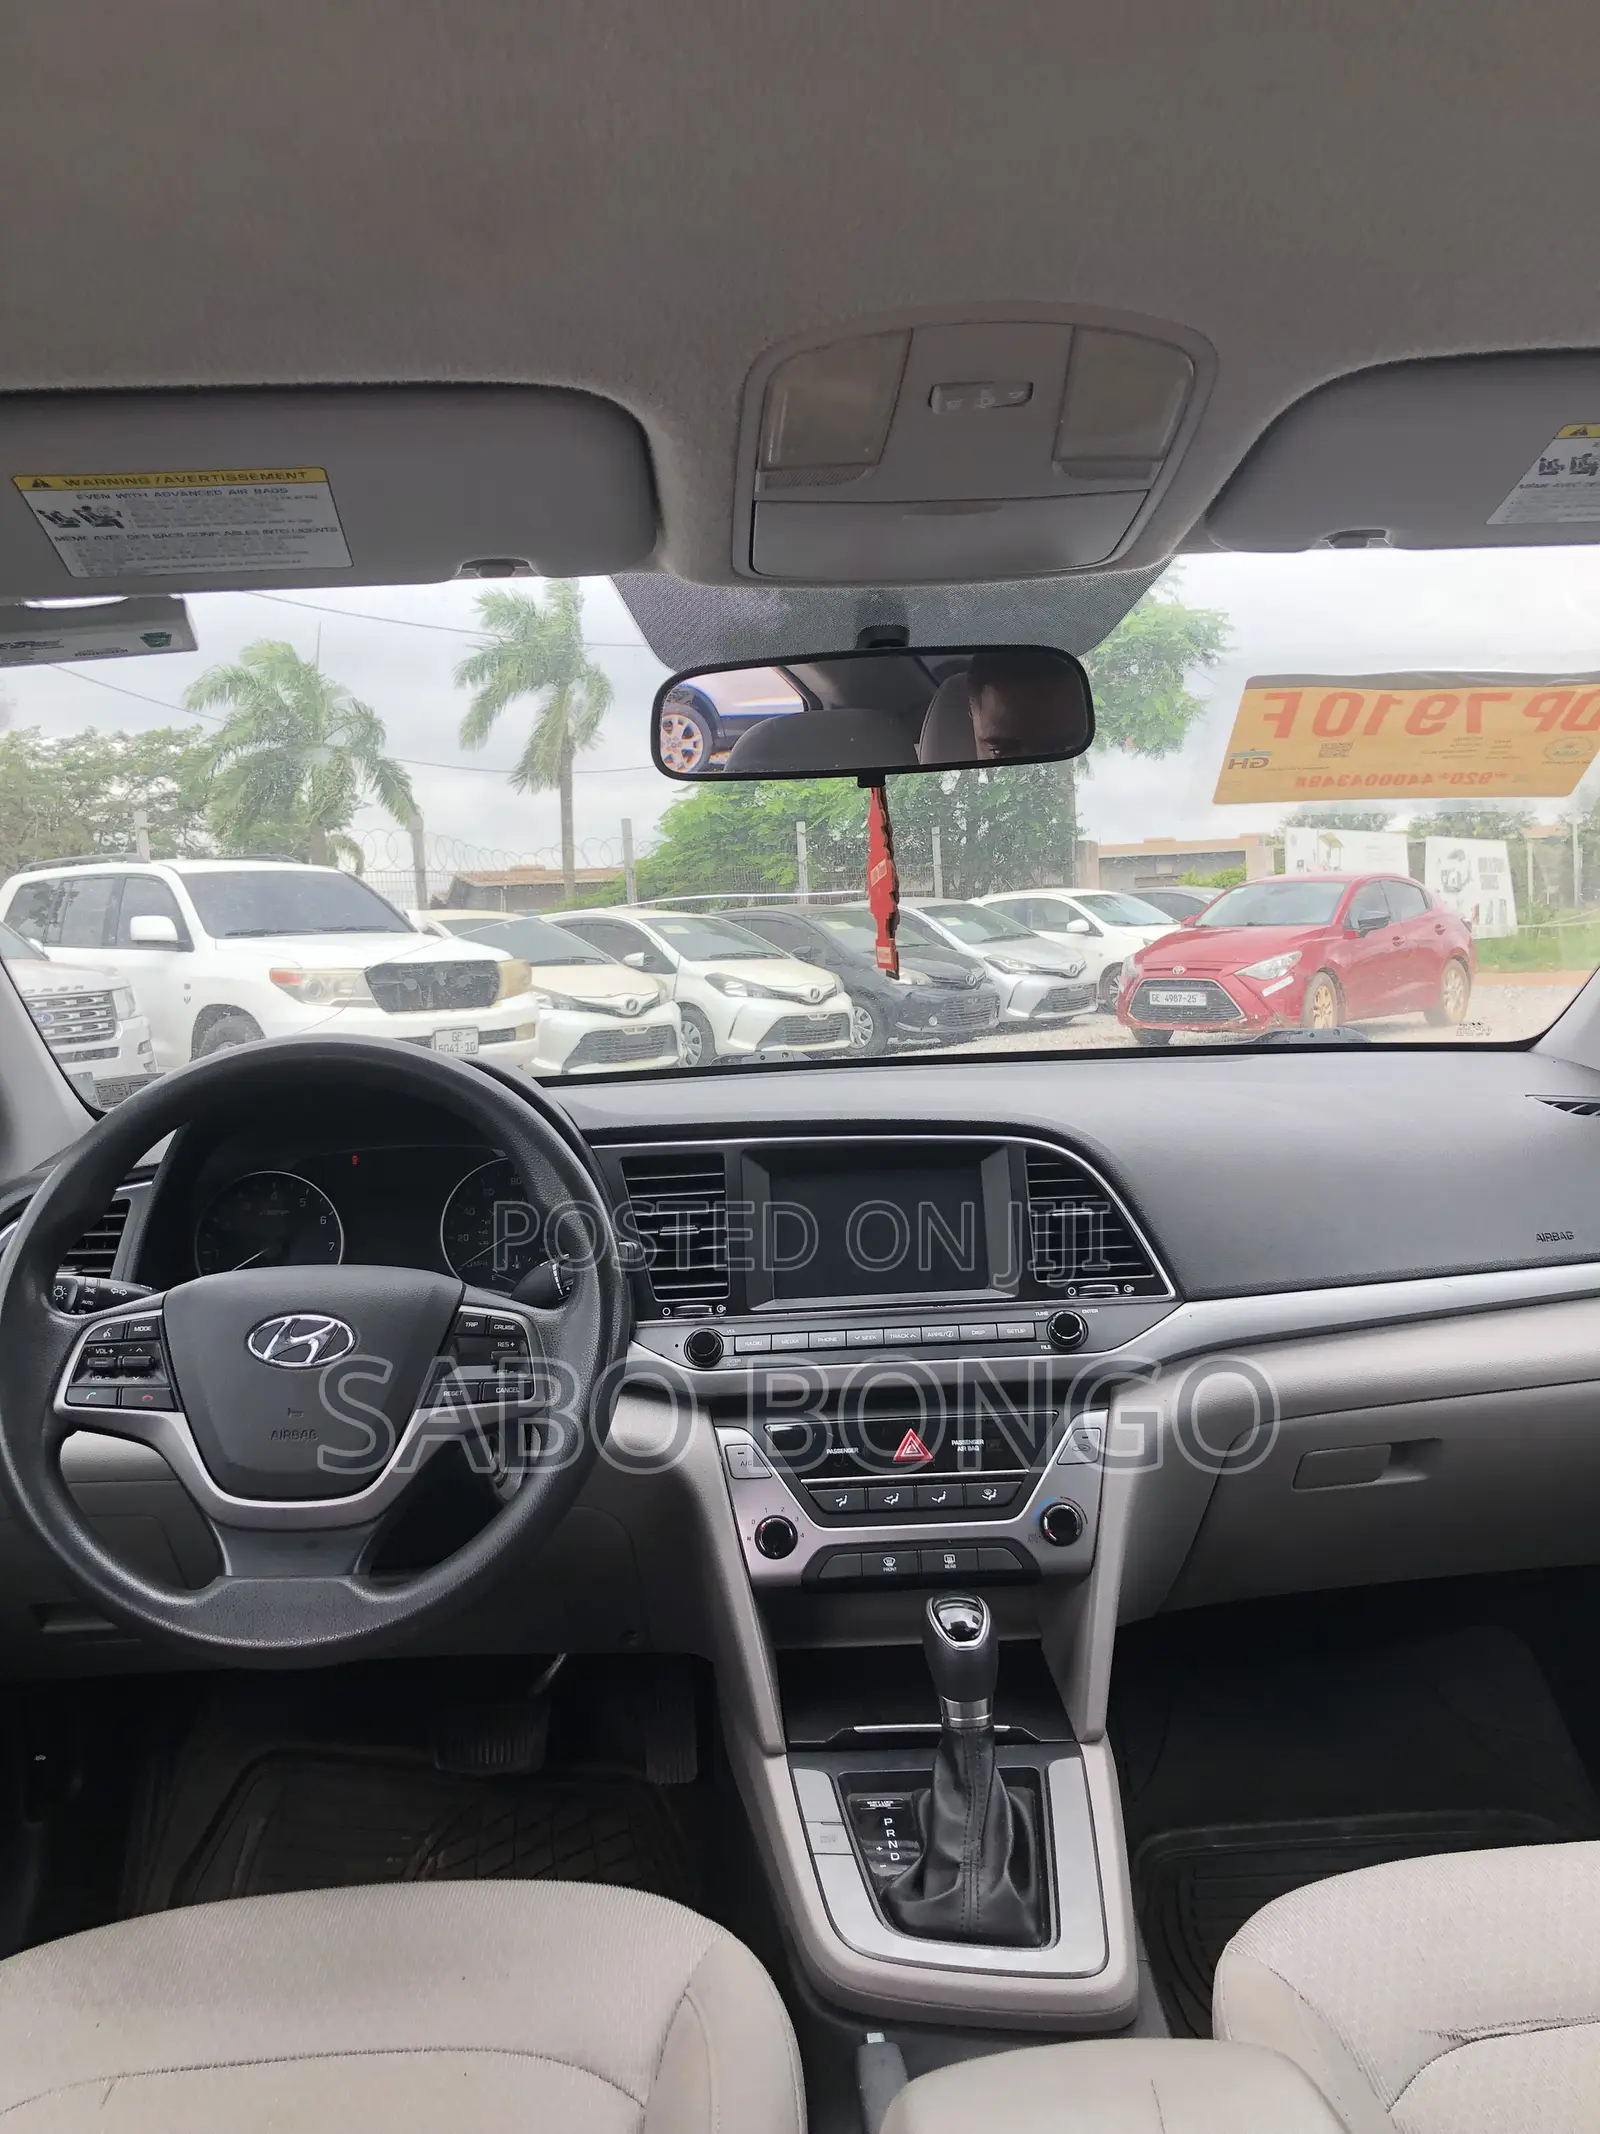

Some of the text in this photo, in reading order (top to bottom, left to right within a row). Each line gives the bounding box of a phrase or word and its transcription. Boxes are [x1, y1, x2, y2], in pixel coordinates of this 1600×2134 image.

[63, 477, 150, 487] WARNING
[164, 471, 307, 485] AVERTISSEMENT
[154, 489, 222, 498] ADVANCED
[228, 487, 249, 496] AIR
[1151, 993, 1197, 1003] GE 4987-25
[299, 1198, 306, 1208] 5
[319, 1215, 327, 1225] 6
[457, 1234, 469, 1242] 20
[1535, 1231, 1575, 1243] AIRBAG
[328, 1241, 336, 1252] 7
[443, 1389, 463, 1397] RESET
[495, 1386, 520, 1394] CANCEL
[270, 1429, 318, 1441] AIRBAG
[951, 1438, 985, 1446] PASSENGER
[826, 1447, 859, 1455] PASSENGER
[888, 1840, 898, 1848] N
